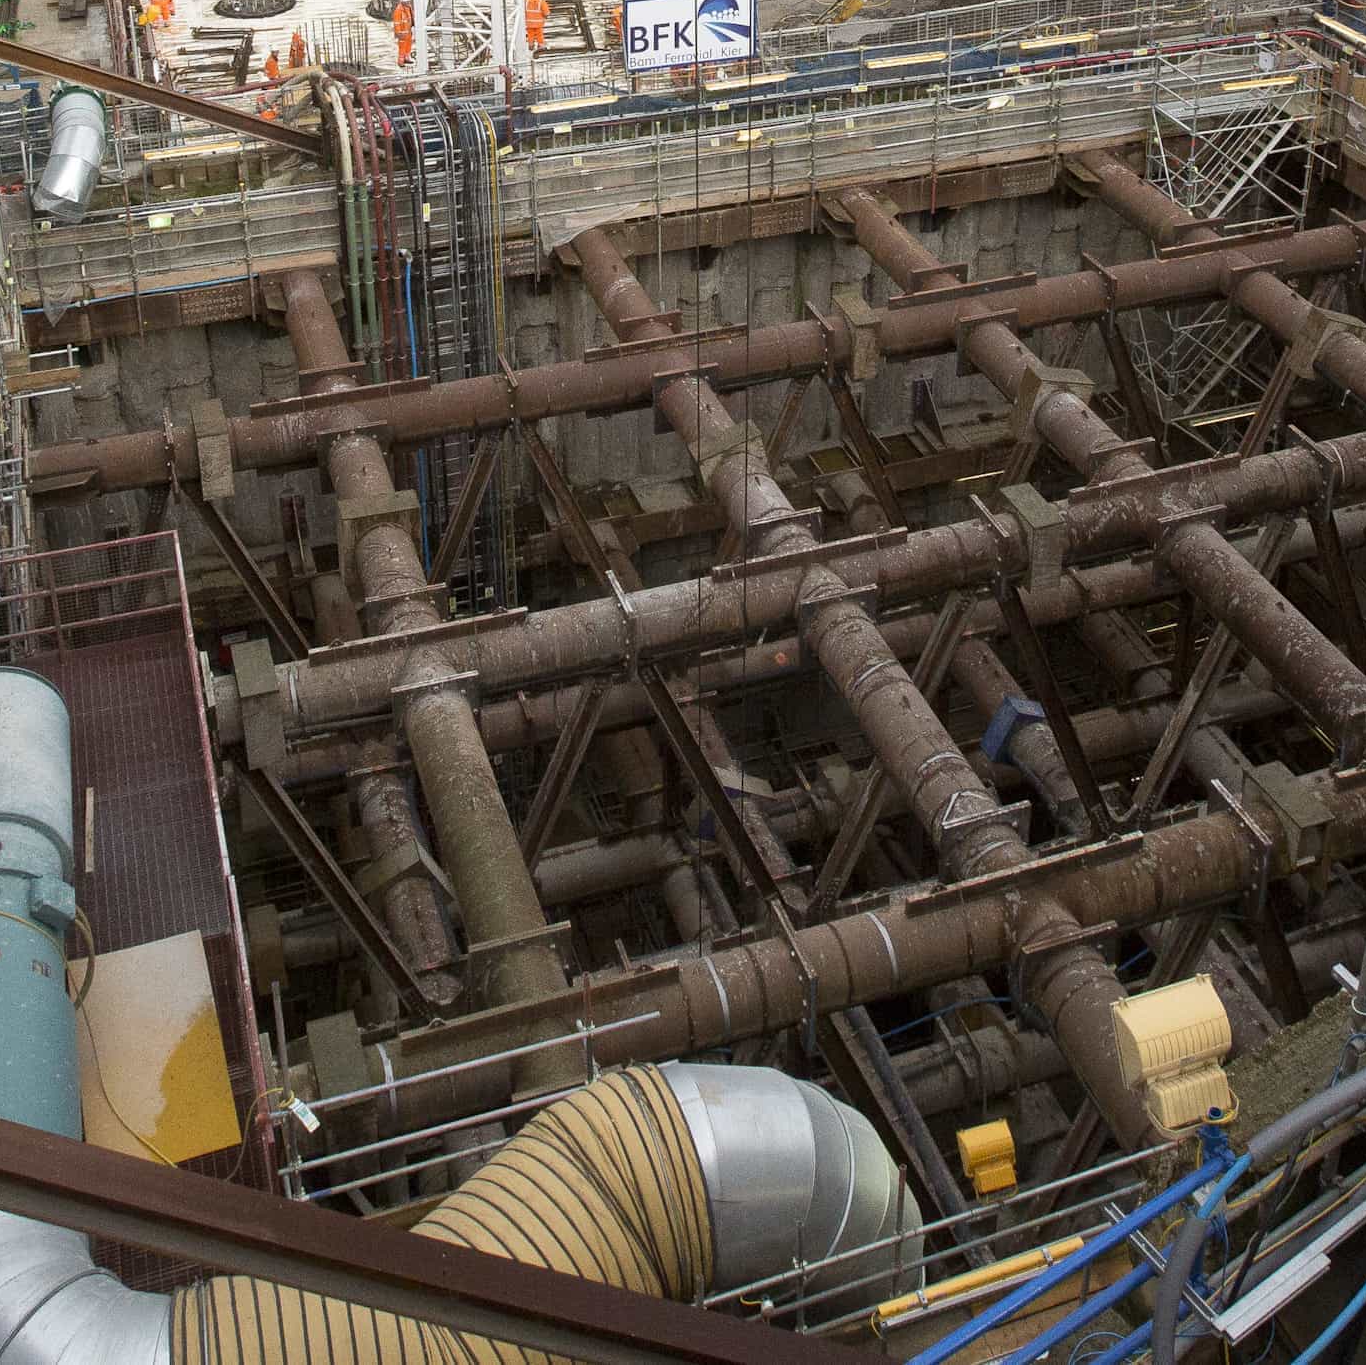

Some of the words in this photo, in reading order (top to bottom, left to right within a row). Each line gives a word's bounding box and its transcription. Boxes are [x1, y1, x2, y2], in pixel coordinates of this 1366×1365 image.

[630, 20, 694, 54] BFK
[630, 56, 656, 68] Bam
[721, 47, 743, 58] Kier
